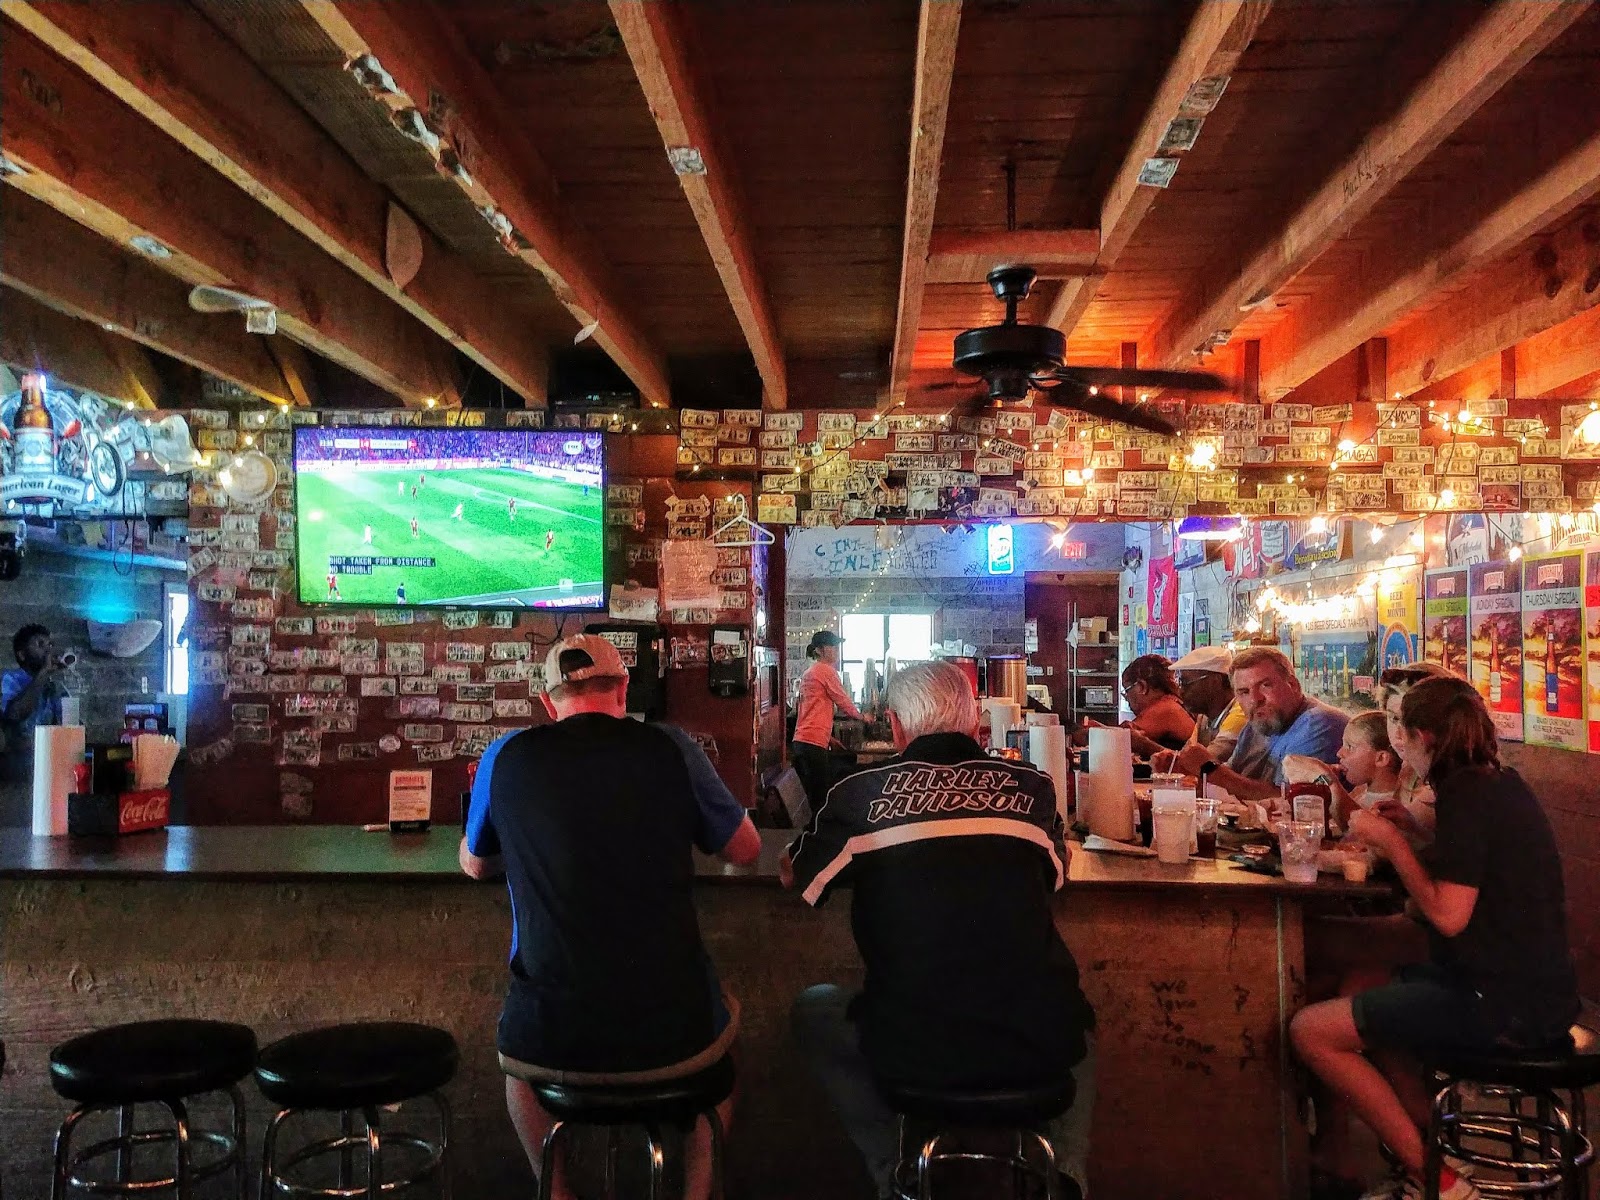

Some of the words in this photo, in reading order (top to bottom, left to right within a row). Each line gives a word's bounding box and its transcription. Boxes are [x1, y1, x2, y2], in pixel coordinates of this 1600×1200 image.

[1064, 542, 1084, 558] EXIT
[350, 557, 372, 565] TAKEN
[375, 557, 393, 565] FROM
[330, 565, 339, 573] NO
[342, 566, 372, 574] TROUBLE
[1390, 591, 1403, 600] BEER
[1525, 594, 1553, 607] THURSDAY
[1554, 591, 1579, 604] SPECIAL
[1387, 608, 1406, 617] MONTH
[867, 791, 1034, 823] DAVIDSON
